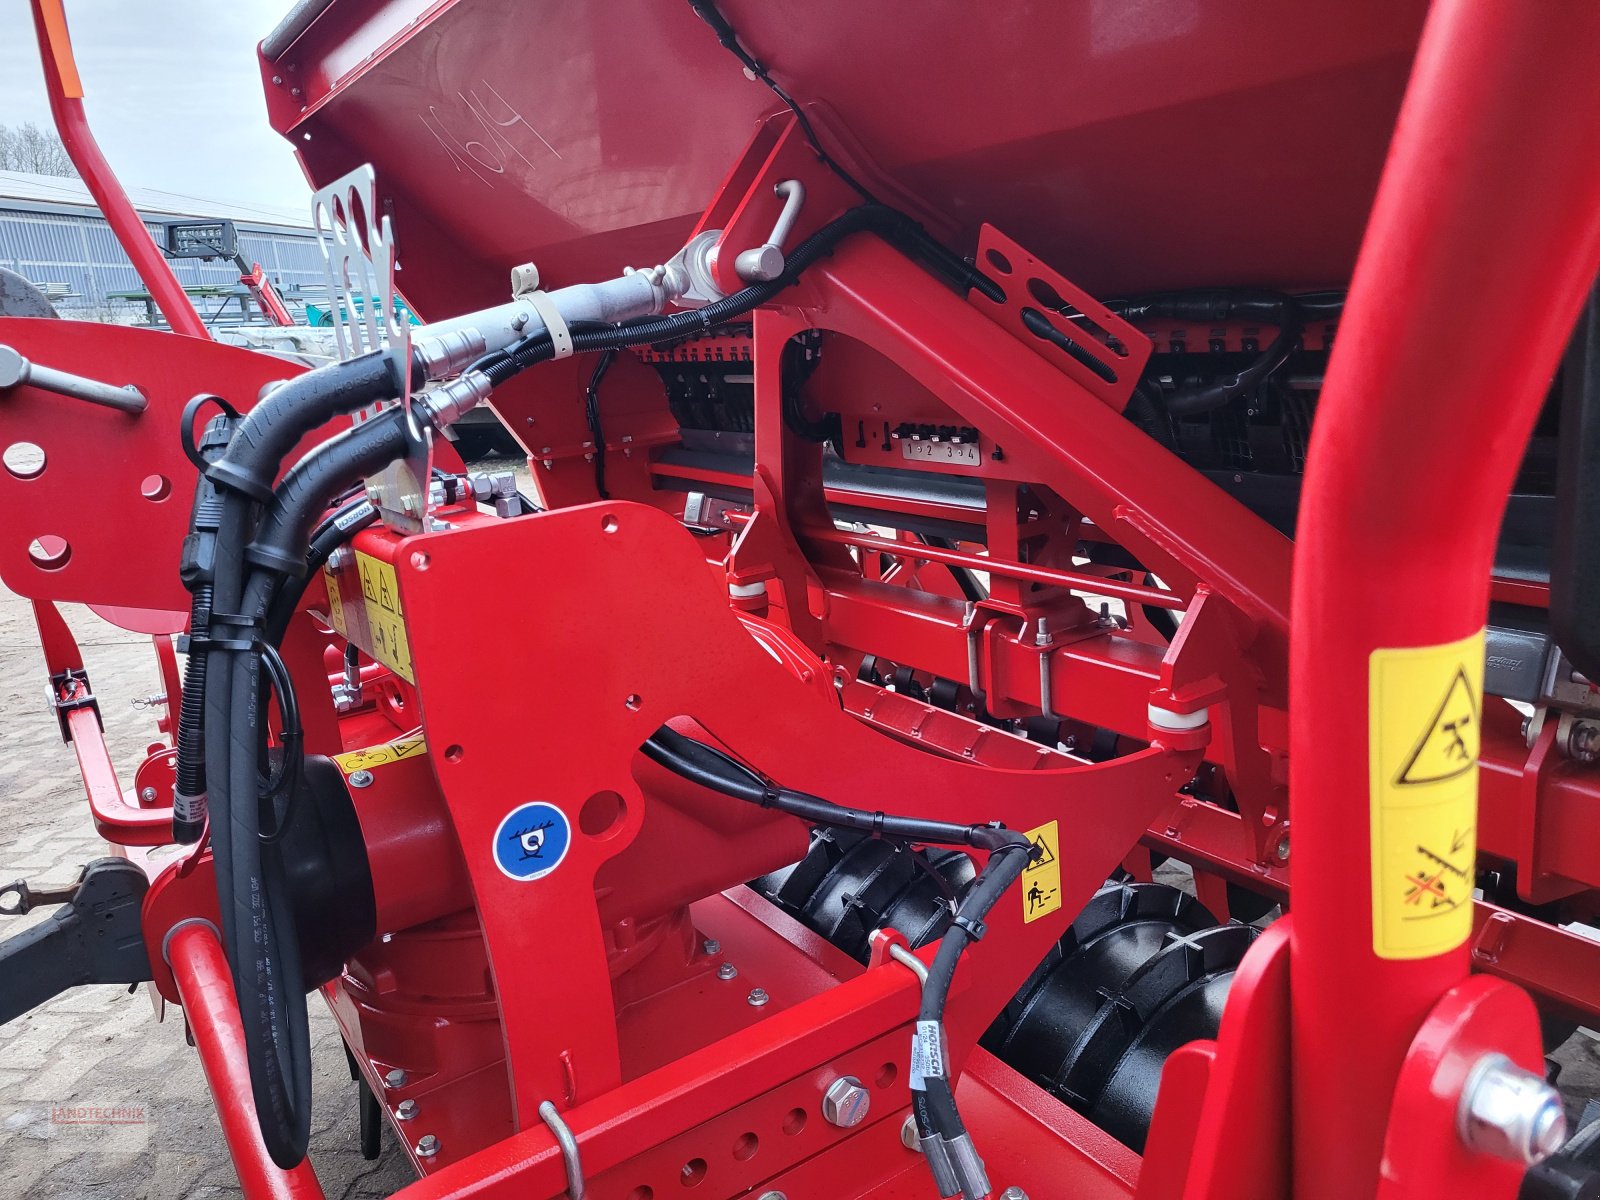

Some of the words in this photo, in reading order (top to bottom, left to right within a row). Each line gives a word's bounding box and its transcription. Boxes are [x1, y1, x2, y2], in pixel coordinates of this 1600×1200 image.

[927, 445, 932, 455] 2
[947, 447, 953, 457] 3
[968, 449, 974, 459] 4
[338, 505, 371, 529] HORSCH
[927, 1024, 941, 1076] HORSCH
